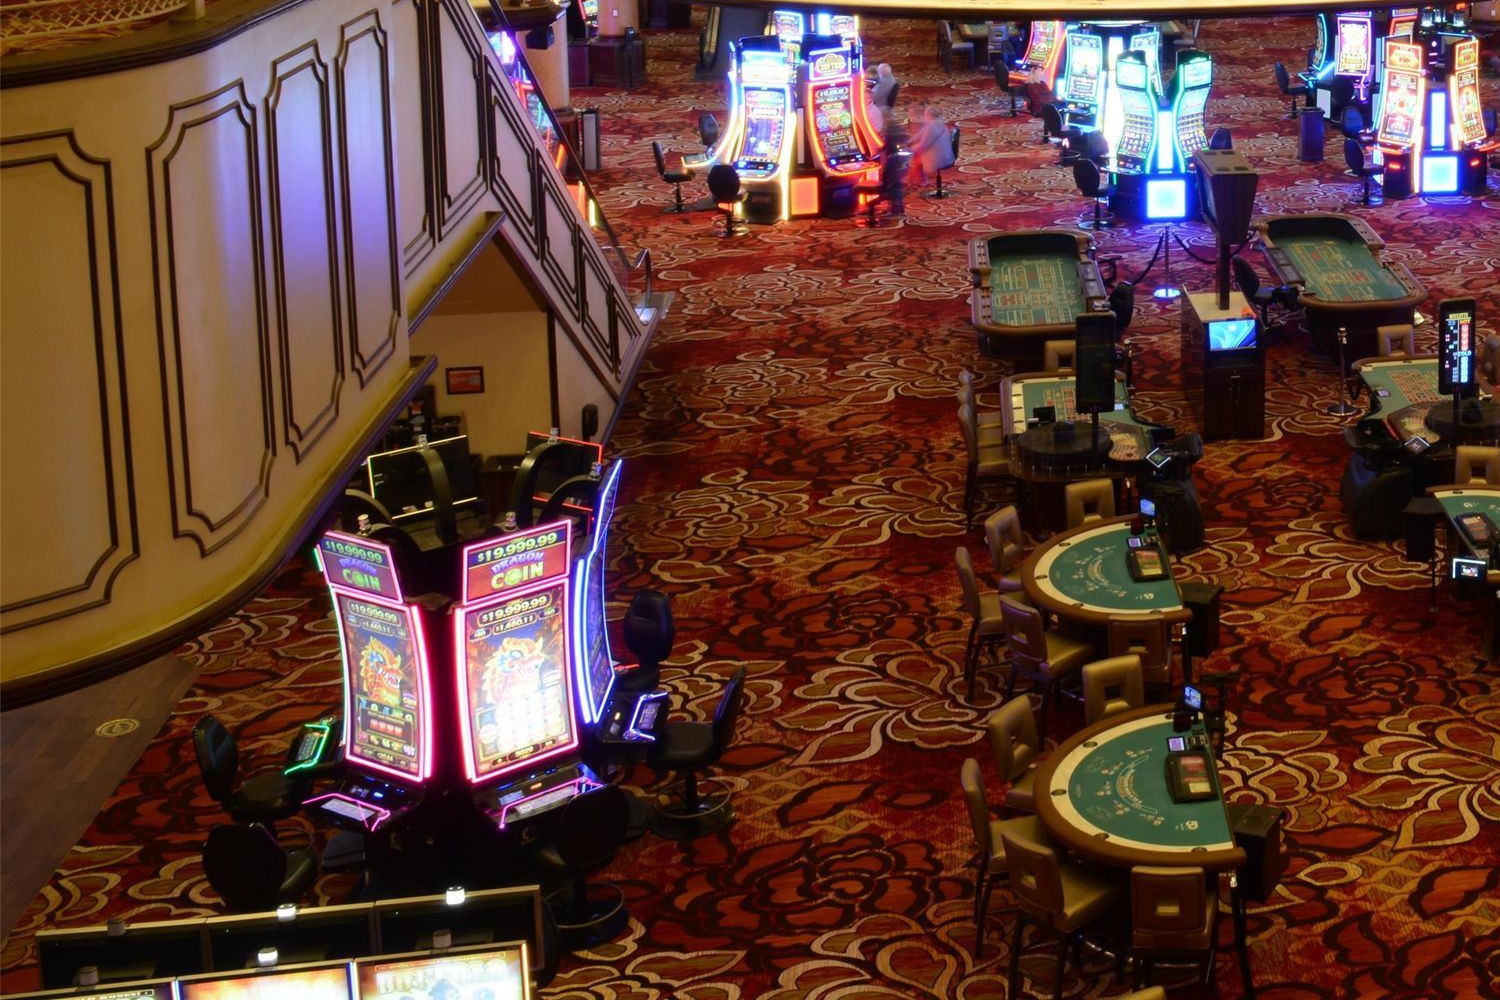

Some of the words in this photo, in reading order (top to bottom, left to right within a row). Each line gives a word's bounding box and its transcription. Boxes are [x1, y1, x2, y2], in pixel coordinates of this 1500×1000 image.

[490, 551, 545, 574] DRAGON
[342, 568, 381, 591] COIN
[491, 561, 544, 589] COIN
